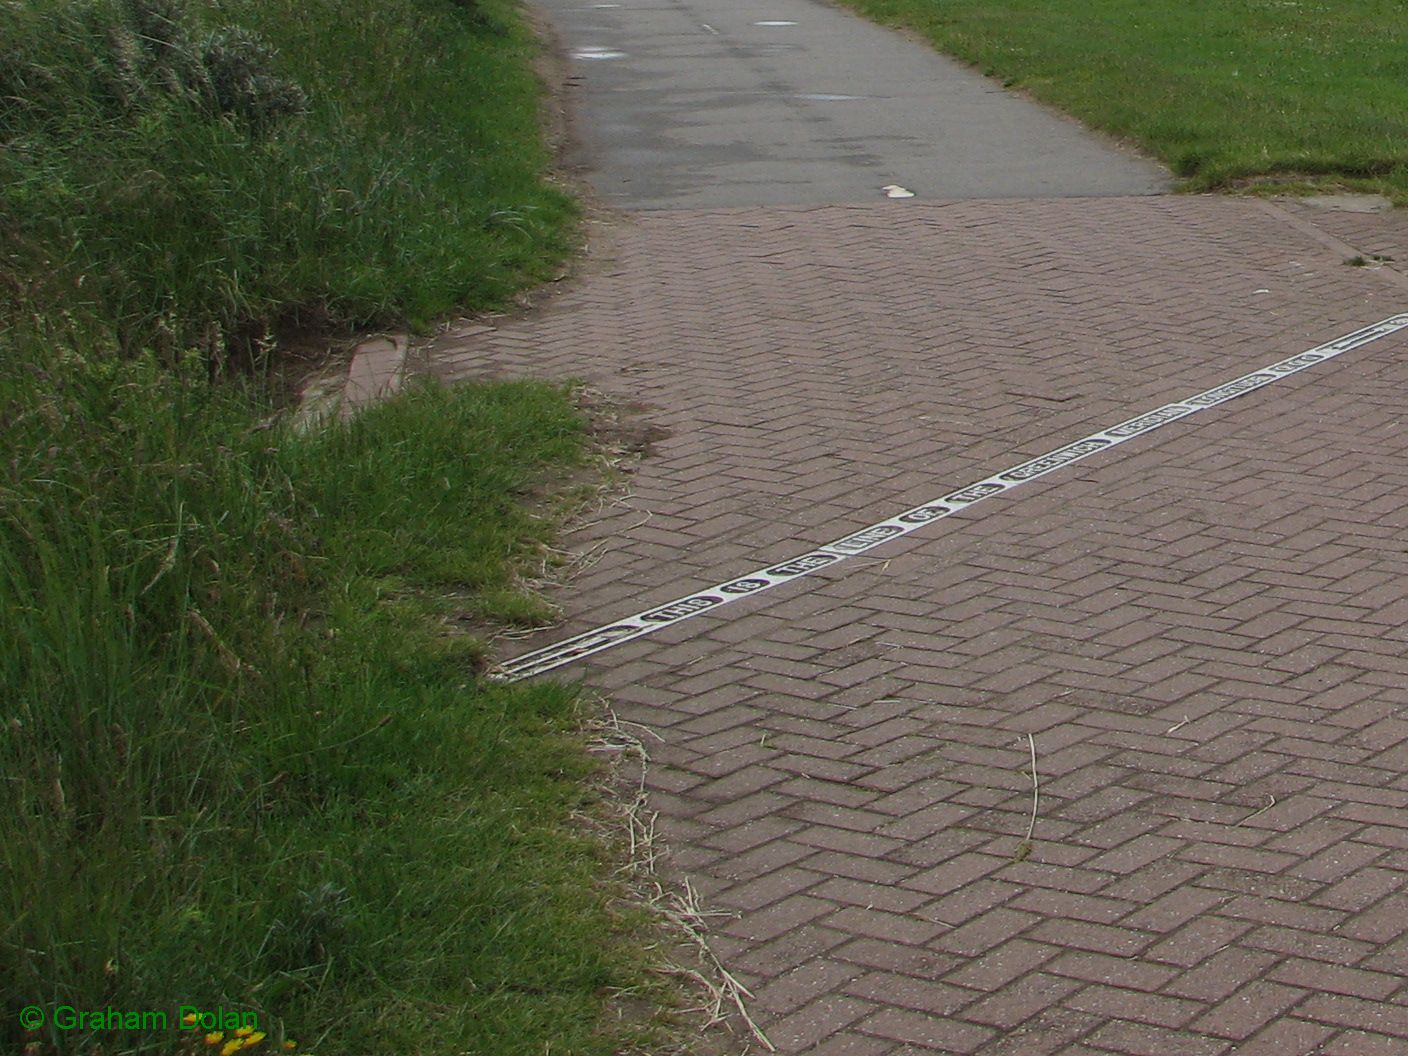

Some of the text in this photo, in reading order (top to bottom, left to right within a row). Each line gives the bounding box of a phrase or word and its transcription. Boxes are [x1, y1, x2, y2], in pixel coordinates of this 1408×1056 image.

[649, 596, 713, 620] THIS
[727, 579, 761, 593] IS
[774, 557, 828, 576] THE
[845, 525, 896, 549] LINE
[907, 507, 944, 522] OF
[950, 484, 999, 503] THE
[1009, 440, 1104, 479] GREENWICH
[1109, 406, 1188, 436] MERIDIAN
